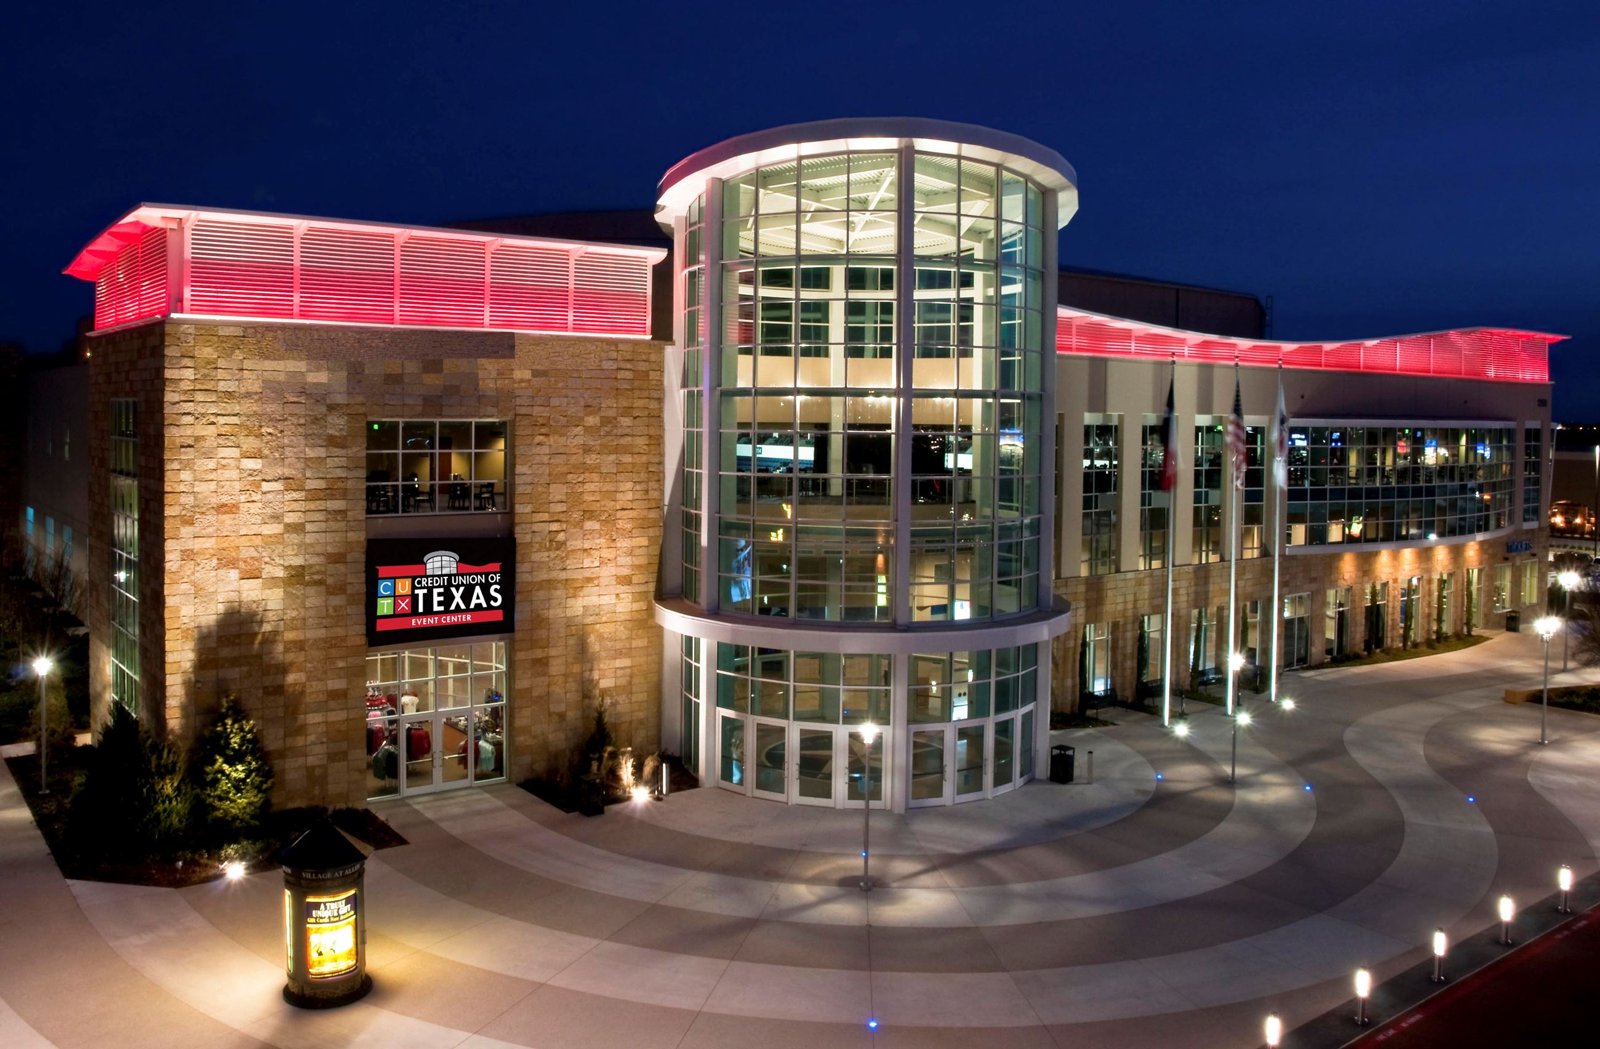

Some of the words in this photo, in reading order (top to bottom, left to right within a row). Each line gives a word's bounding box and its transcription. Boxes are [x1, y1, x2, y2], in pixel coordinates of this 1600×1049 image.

[414, 576, 449, 587] CREDIT
[451, 574, 485, 586] UNION
[488, 573, 501, 583] OF
[414, 584, 503, 613] TEXAS
[411, 616, 439, 626] EVENT
[441, 614, 472, 624] CENTER
[301, 871, 332, 880] VILLAGE
